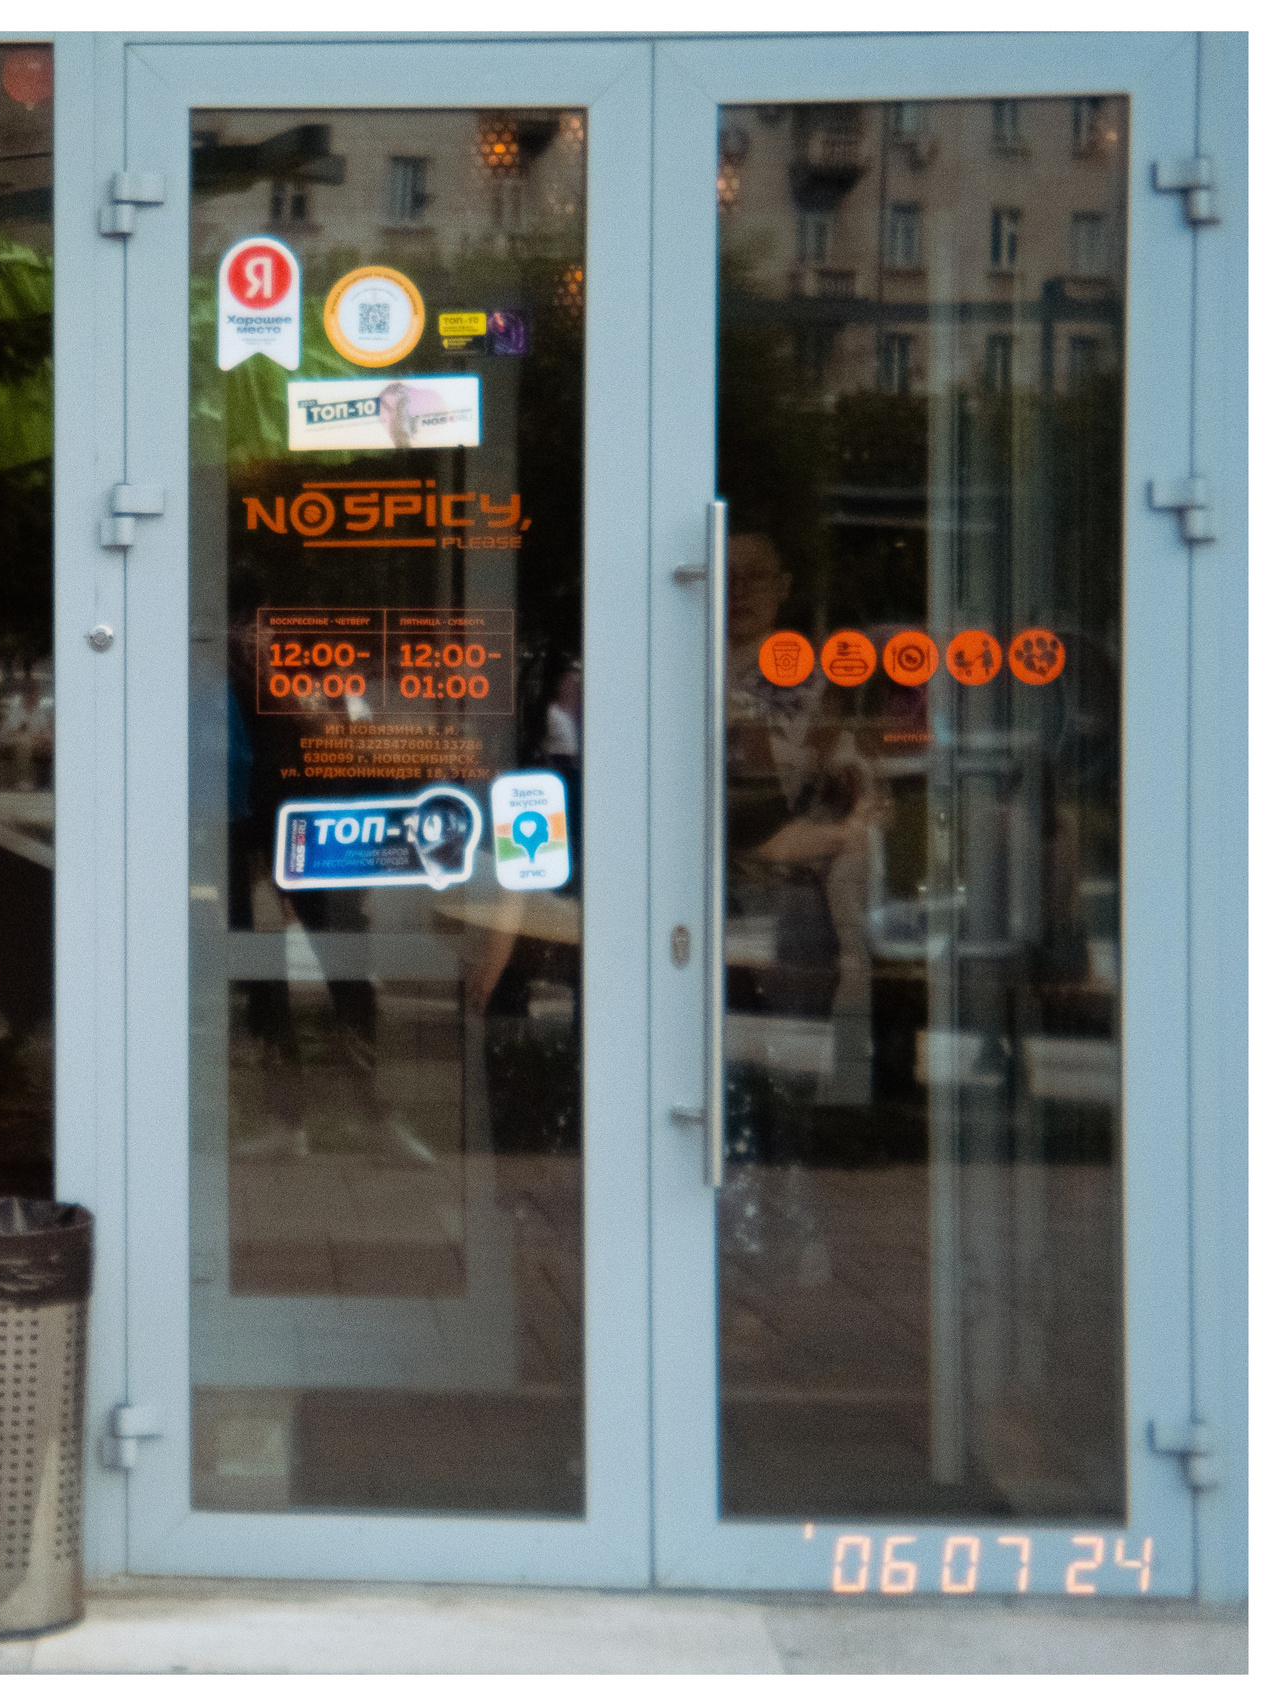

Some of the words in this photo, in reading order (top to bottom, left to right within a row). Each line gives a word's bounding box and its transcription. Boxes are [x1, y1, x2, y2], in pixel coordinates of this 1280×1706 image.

[243, 256, 273, 299] Я
[227, 315, 292, 328] Хорошее
[235, 325, 282, 335] место
[310, 400, 376, 422] ТОП-10
[242, 491, 336, 537] NO
[442, 535, 522, 550] PLEASE
[270, 617, 329, 626] ВОСКРЕСЕНЬЕ
[335, 617, 370, 626] ЧЕТВЕРГ
[400, 617, 441, 627] ПЯТНИЦА
[447, 618, 486, 627] СУББОТА
[270, 643, 370, 667] 12:00-
[400, 644, 502, 668] 12:00-
[270, 674, 366, 698] 00:00
[400, 675, 489, 699] 01:00
[325, 725, 345, 736] ИП
[349, 725, 424, 736] КОВЯЗИНА
[300, 738, 353, 749] ЕГРНИП
[304, 753, 353, 763] 630099
[358, 755, 368, 763] г.
[280, 768, 301, 779] ул.
[305, 767, 422, 779] ОРДЖОНИКИДЗЕ
[512, 788, 544, 798] Здесь
[509, 798, 548, 808] вкусно
[314, 814, 443, 845] ТОП-10
[519, 870, 545, 878] 2ГИС
